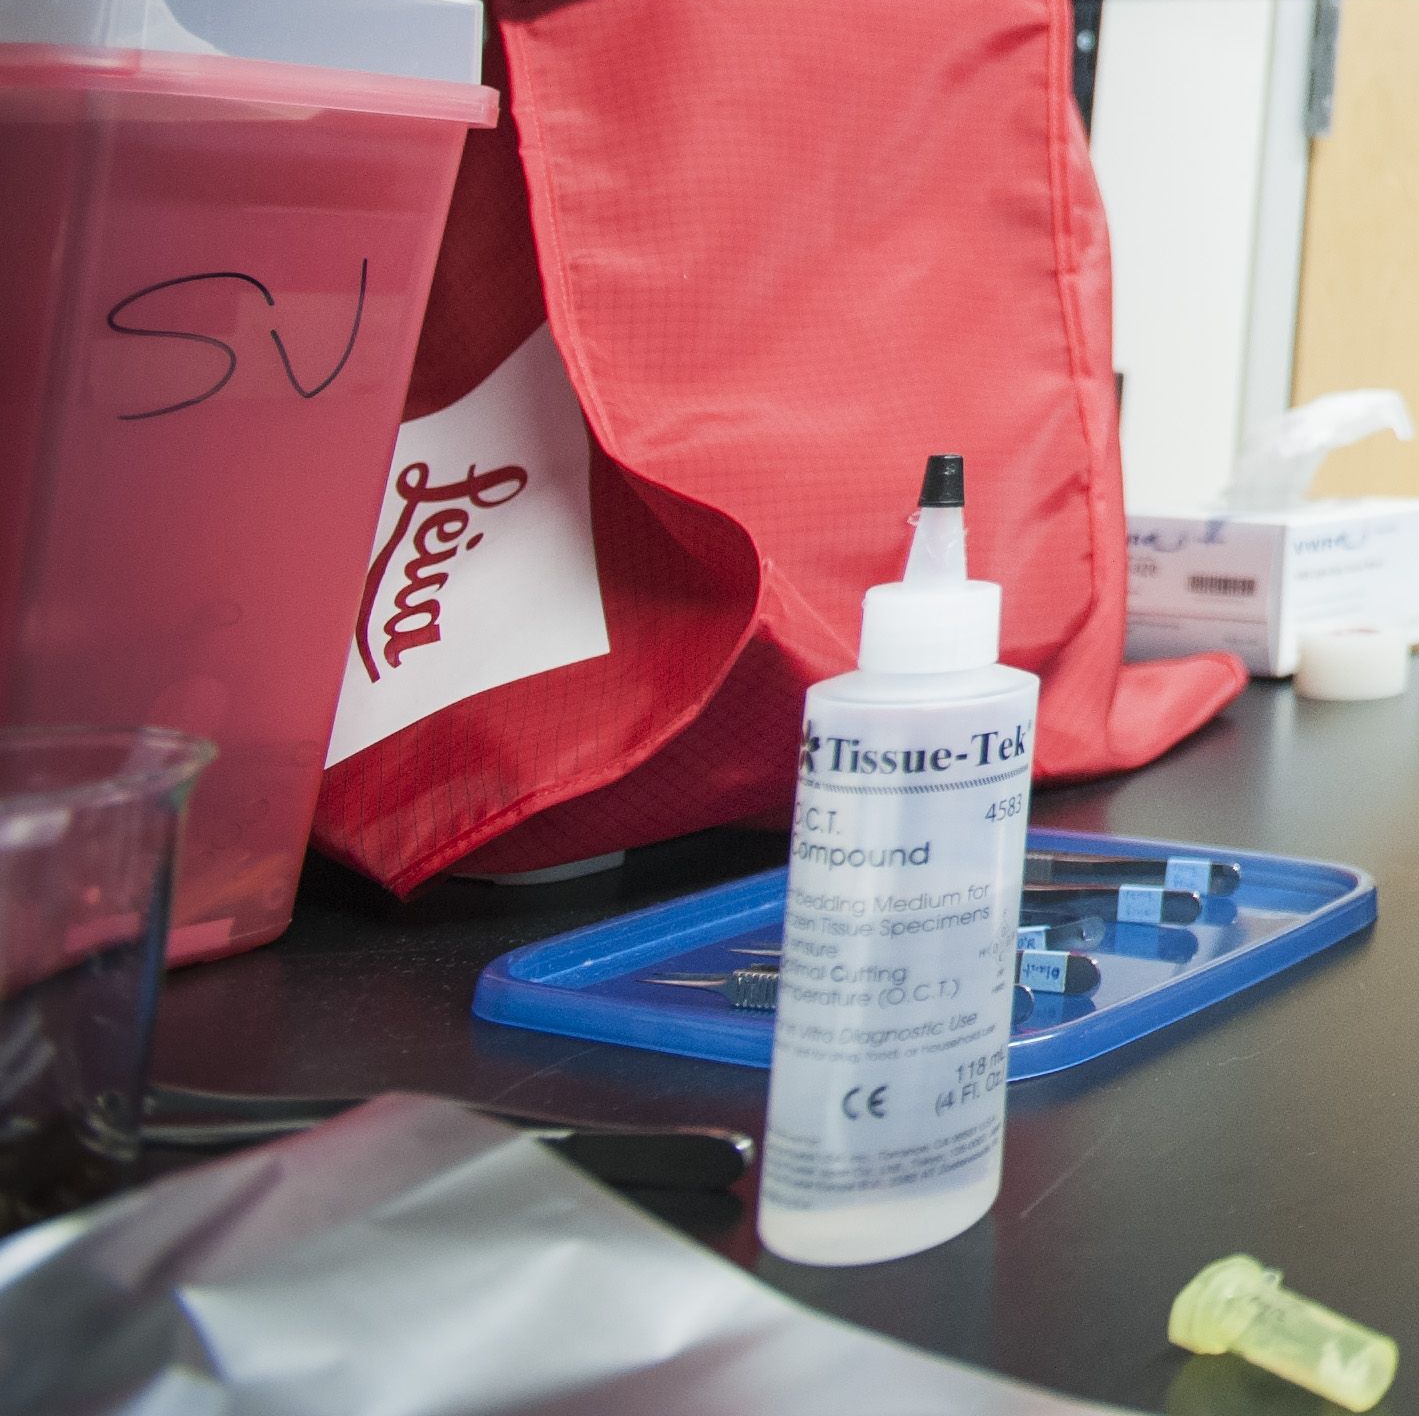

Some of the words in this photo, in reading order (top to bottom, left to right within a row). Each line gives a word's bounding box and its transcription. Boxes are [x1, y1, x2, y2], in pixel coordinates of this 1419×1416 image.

[355, 461, 528, 684] Leica
[827, 724, 1026, 775] Tissue-Tek
[984, 793, 1023, 823] 4583
[874, 891, 961, 914] Medium
[967, 883, 992, 902] for
[879, 905, 990, 939] Specimens
[830, 964, 907, 986] Cutting
[949, 1011, 978, 1031] Use
